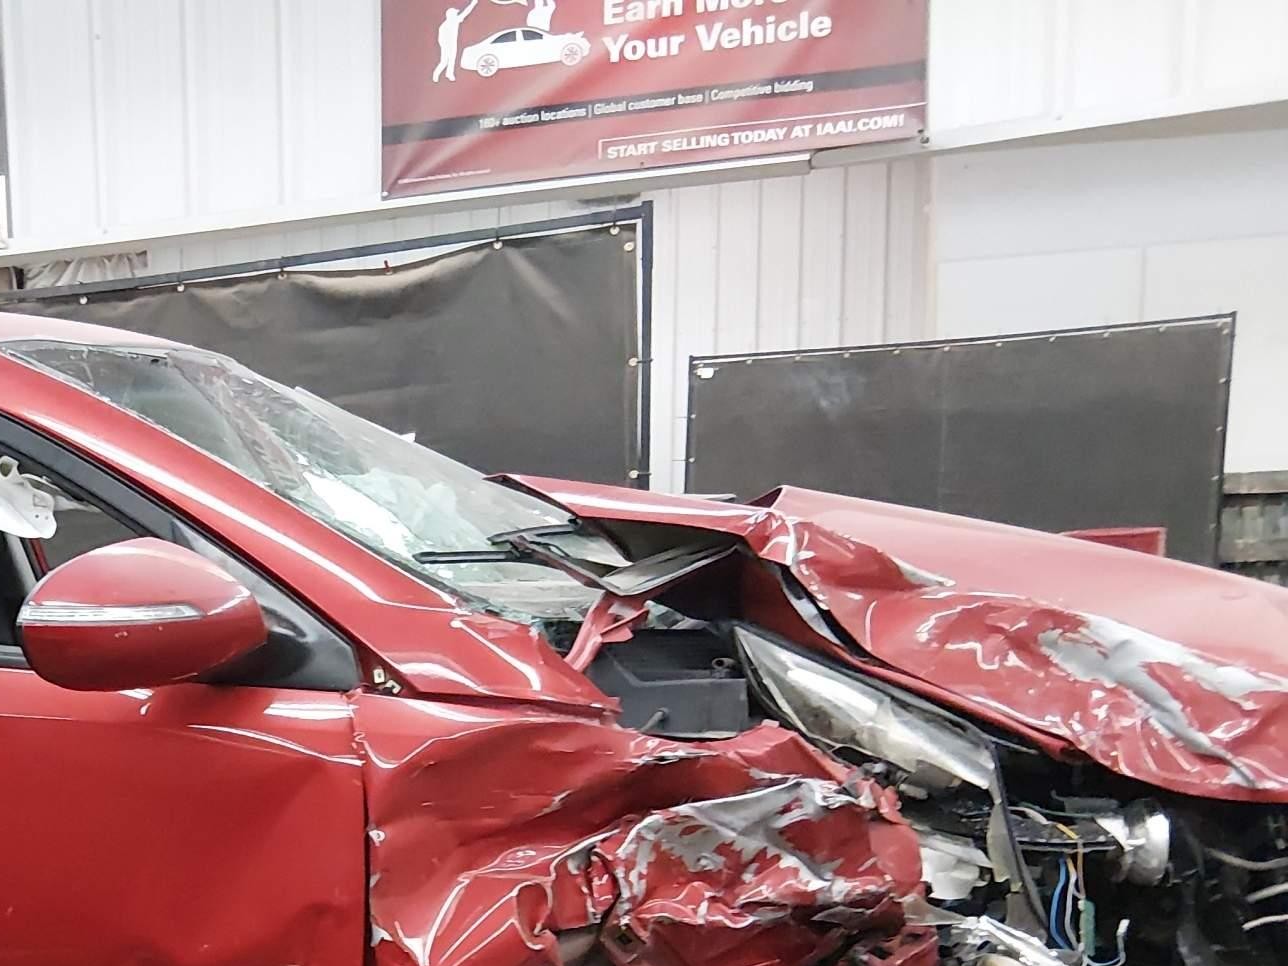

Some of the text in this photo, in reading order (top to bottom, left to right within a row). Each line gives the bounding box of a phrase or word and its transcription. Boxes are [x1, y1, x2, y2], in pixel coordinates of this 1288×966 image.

[601, 11, 833, 63] Your Vehicle
[502, 112, 539, 126] auction
[541, 106, 587, 121] locations
[593, 101, 626, 115] Global
[677, 92, 703, 105] base
[773, 79, 814, 94] bidding
[607, 113, 905, 159] START SELLING TODAY AT IAAI.COM!
